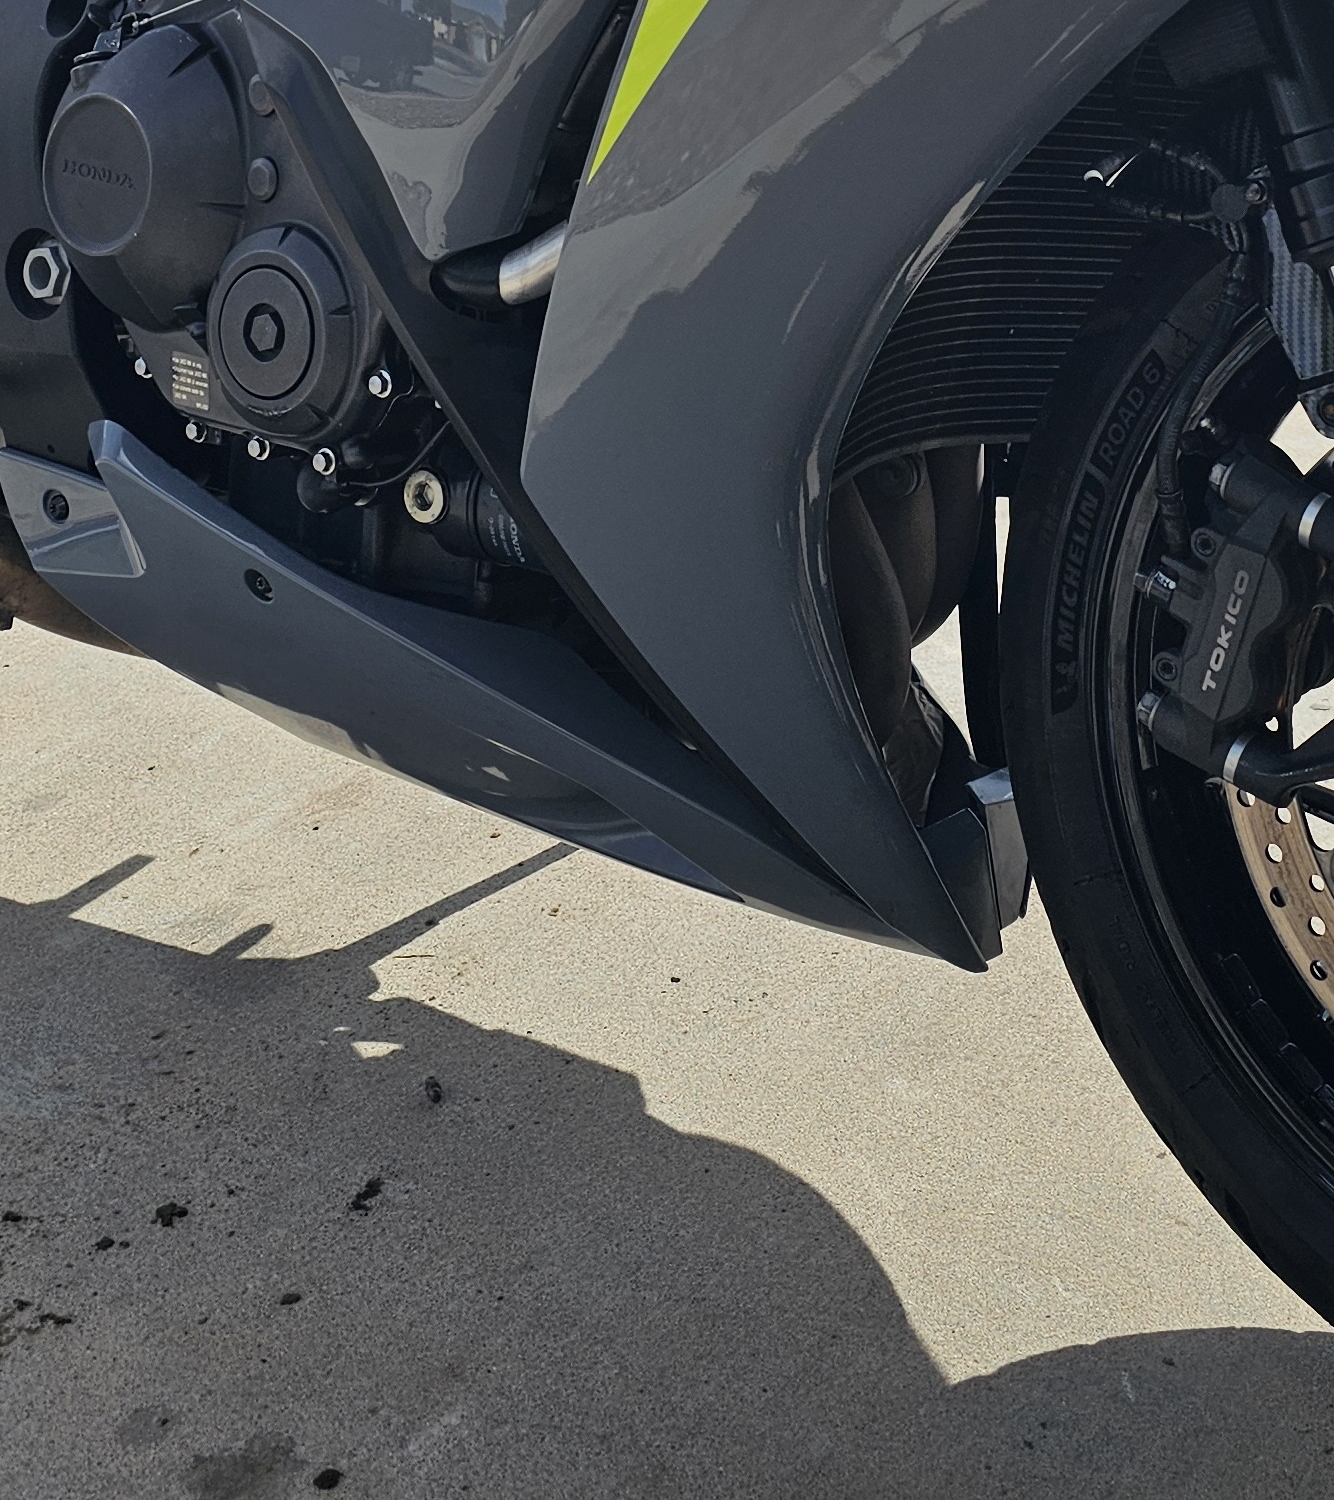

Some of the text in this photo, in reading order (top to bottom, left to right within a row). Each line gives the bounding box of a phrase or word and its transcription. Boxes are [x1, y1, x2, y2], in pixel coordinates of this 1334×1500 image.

[62, 158, 137, 190] HONDA
[1056, 362, 1161, 654] MICHELIN ROAD 6
[1201, 568, 1251, 693] TOKICO
